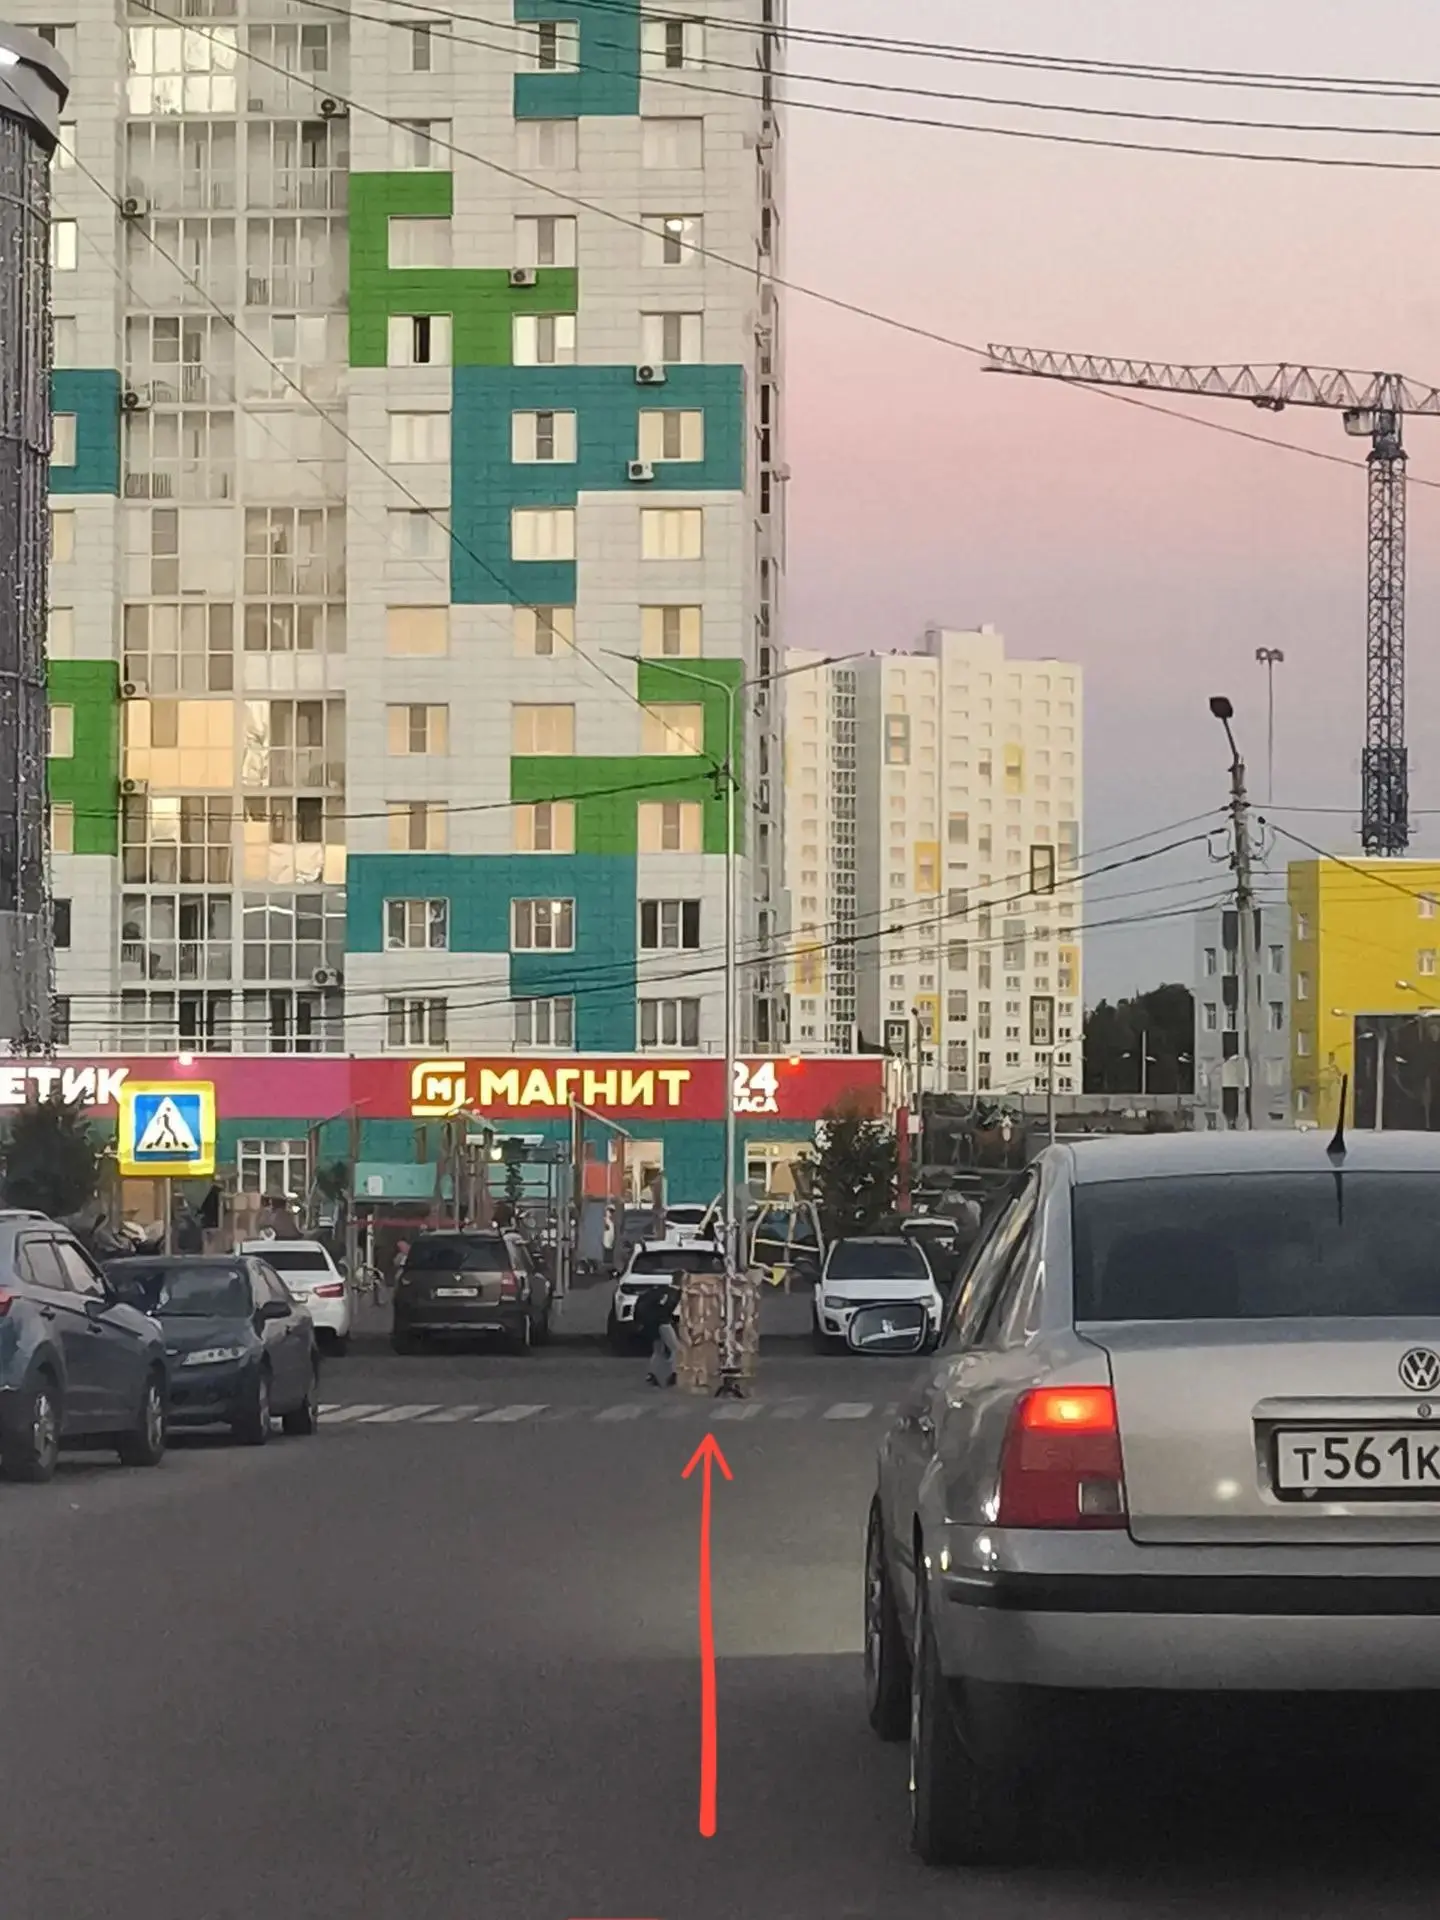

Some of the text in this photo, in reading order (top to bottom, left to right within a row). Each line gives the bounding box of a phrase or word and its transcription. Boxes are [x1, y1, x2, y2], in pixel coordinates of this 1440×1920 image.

[0, 1066, 130, 1105] ЕТИК
[480, 1068, 691, 1106] МАГНИТ
[733, 1061, 779, 1097] 24
